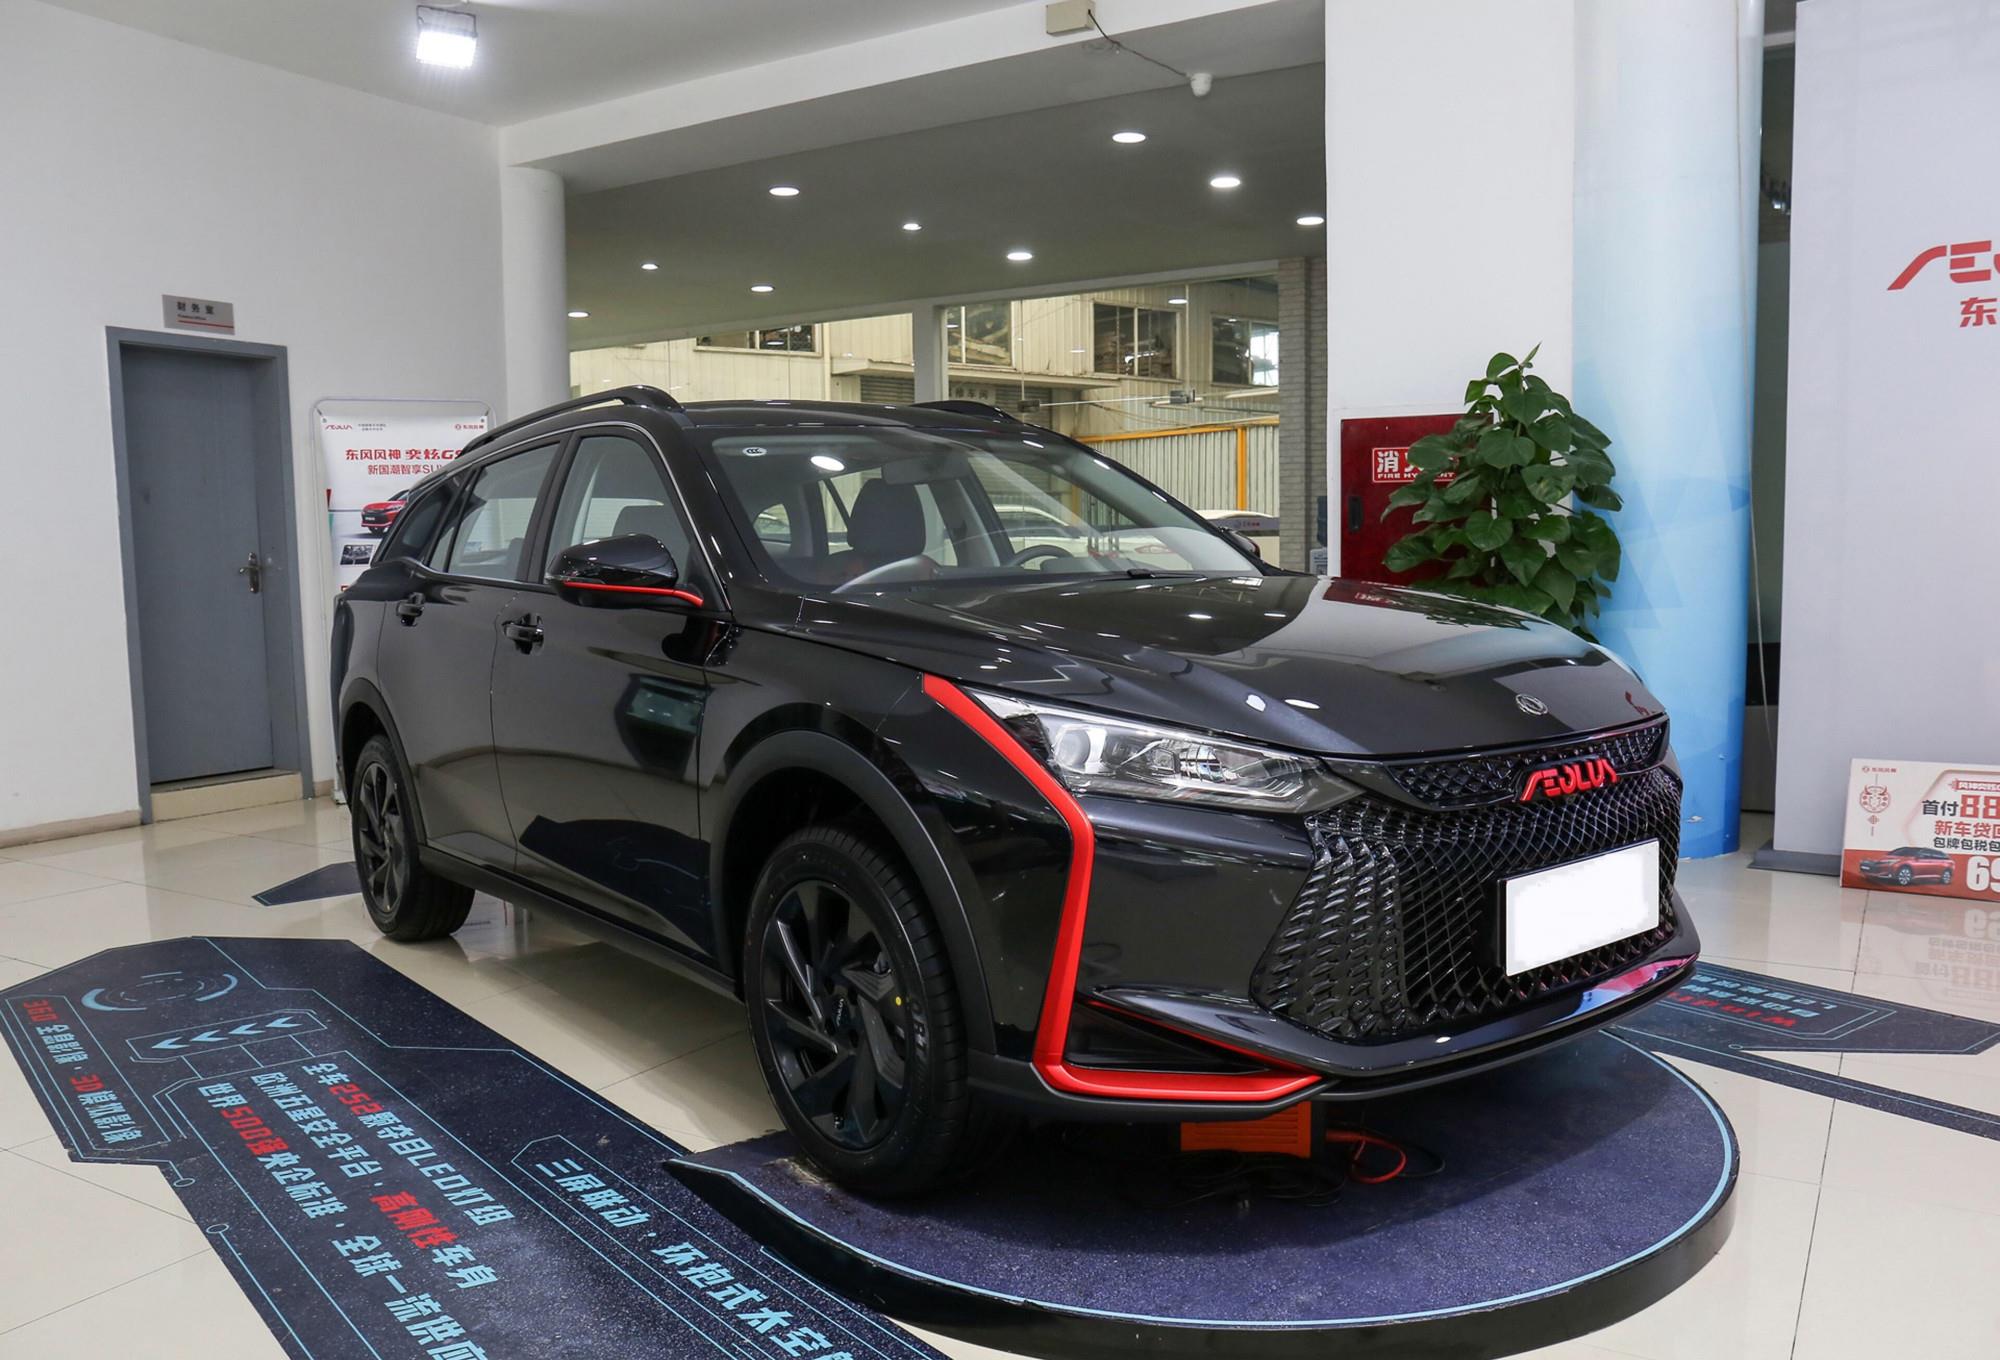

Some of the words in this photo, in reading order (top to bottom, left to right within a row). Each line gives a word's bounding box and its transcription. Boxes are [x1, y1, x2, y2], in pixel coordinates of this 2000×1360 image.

[1887, 240, 2000, 291] AE
[346, 449, 401, 460] 东风风神
[535, 1158, 854, 1360] 三屏联动·环抱式太空
